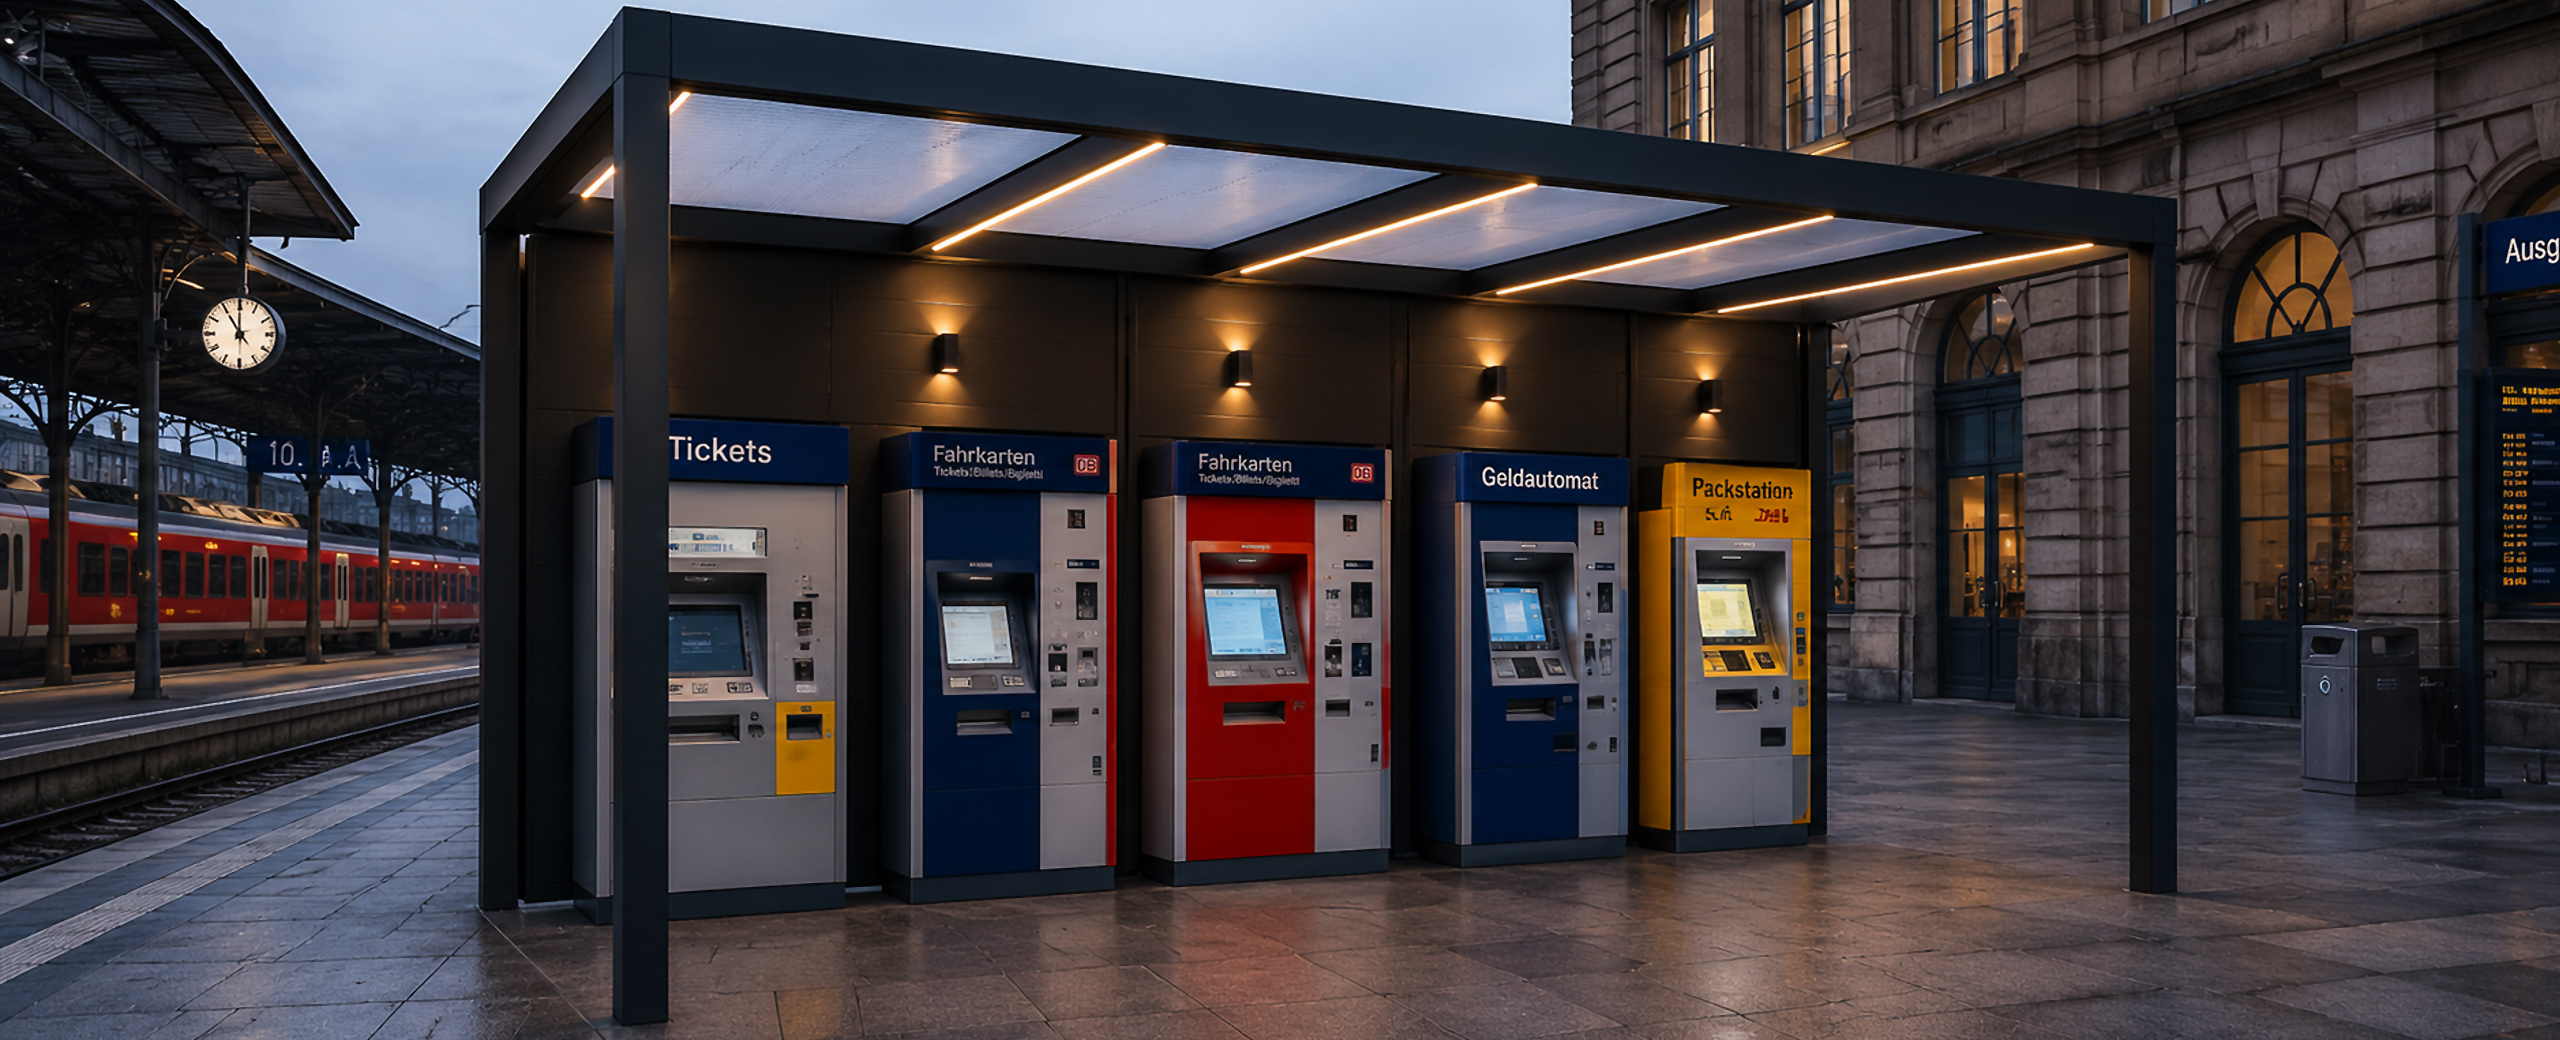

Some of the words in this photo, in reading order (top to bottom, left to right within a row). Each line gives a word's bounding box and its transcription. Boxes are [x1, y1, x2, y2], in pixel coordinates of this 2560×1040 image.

[2505, 237, 2560, 264] Ausg
[668, 435, 772, 464] Tickets
[933, 444, 1036, 466] Fahrkarten
[1198, 452, 1293, 473] Fahrkarten
[1481, 466, 1600, 490] Geldautomat
[1692, 477, 1794, 499] Packstation
